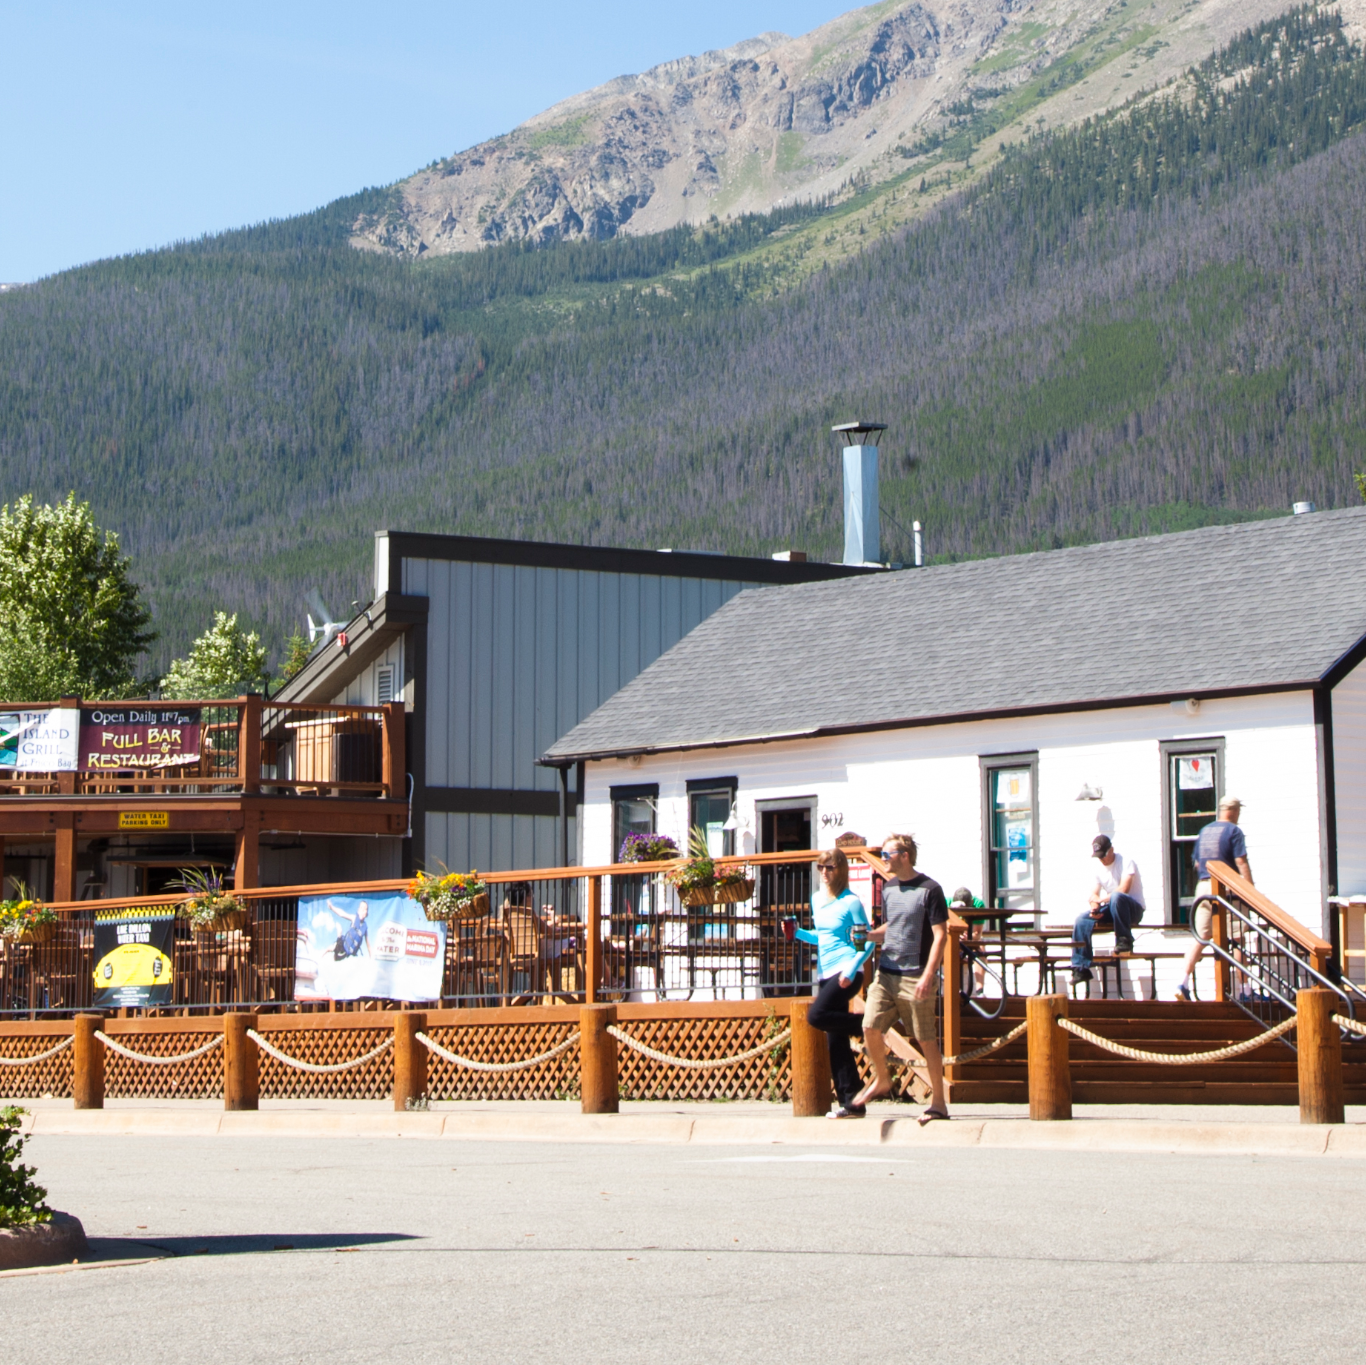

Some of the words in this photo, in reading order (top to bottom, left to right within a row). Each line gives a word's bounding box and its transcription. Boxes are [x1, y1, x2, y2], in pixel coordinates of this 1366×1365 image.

[23, 713, 49, 724] THE
[91, 710, 125, 725] Open
[129, 710, 157, 725] Daily
[23, 727, 70, 740] ISLAND
[102, 731, 143, 748] FULL
[147, 728, 182, 744] BAR
[22, 742, 63, 756] GRILL
[160, 742, 171, 753] &
[58, 758, 72, 770] Bay
[87, 752, 195, 768] RESTAURANT
[822, 812, 844, 829] 902
